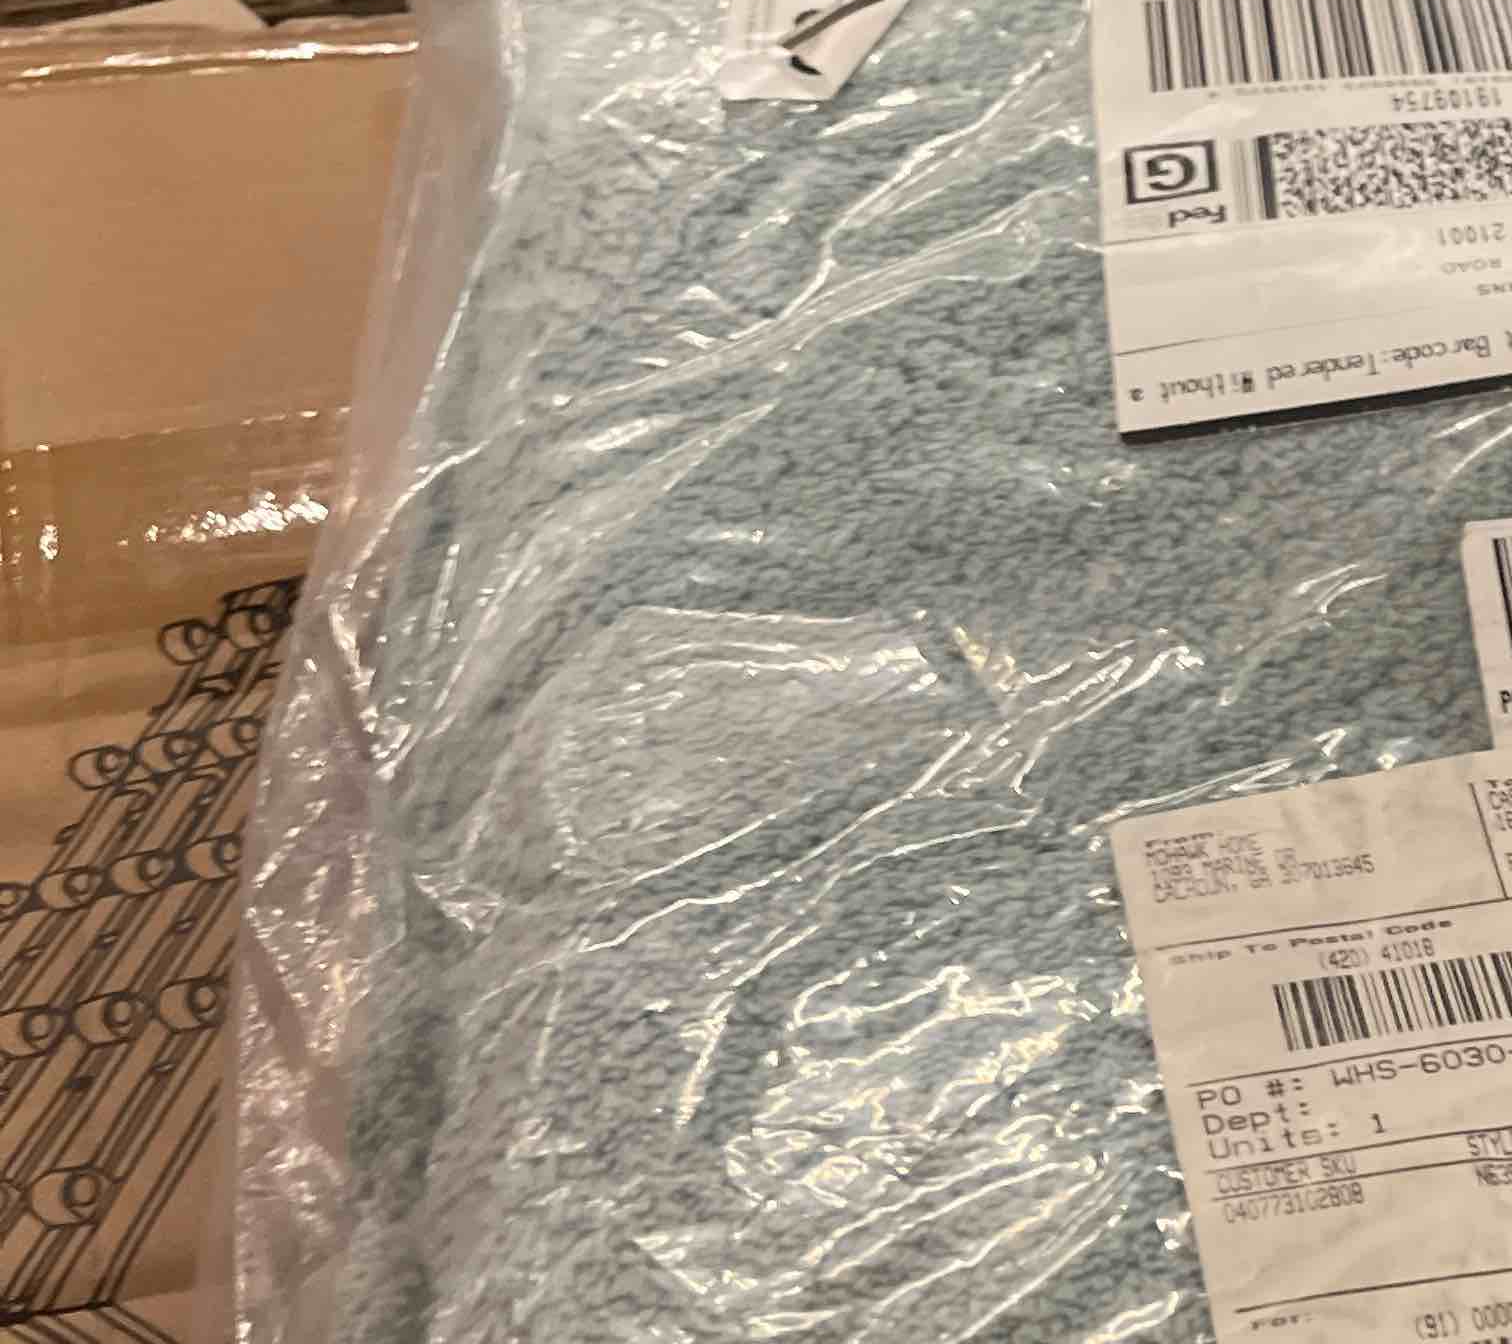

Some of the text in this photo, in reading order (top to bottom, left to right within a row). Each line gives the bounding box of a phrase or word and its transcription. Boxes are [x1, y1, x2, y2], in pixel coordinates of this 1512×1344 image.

[1144, 155, 1197, 192] G
[1167, 204, 1228, 230] Fed
[1197, 1086, 1242, 1111] PO
[1200, 1101, 1312, 1137] Dept:
[1208, 1113, 1388, 1161] Units: 1
[1321, 1156, 1360, 1178] SKU
[1414, 1309, 1460, 1341] (91)
